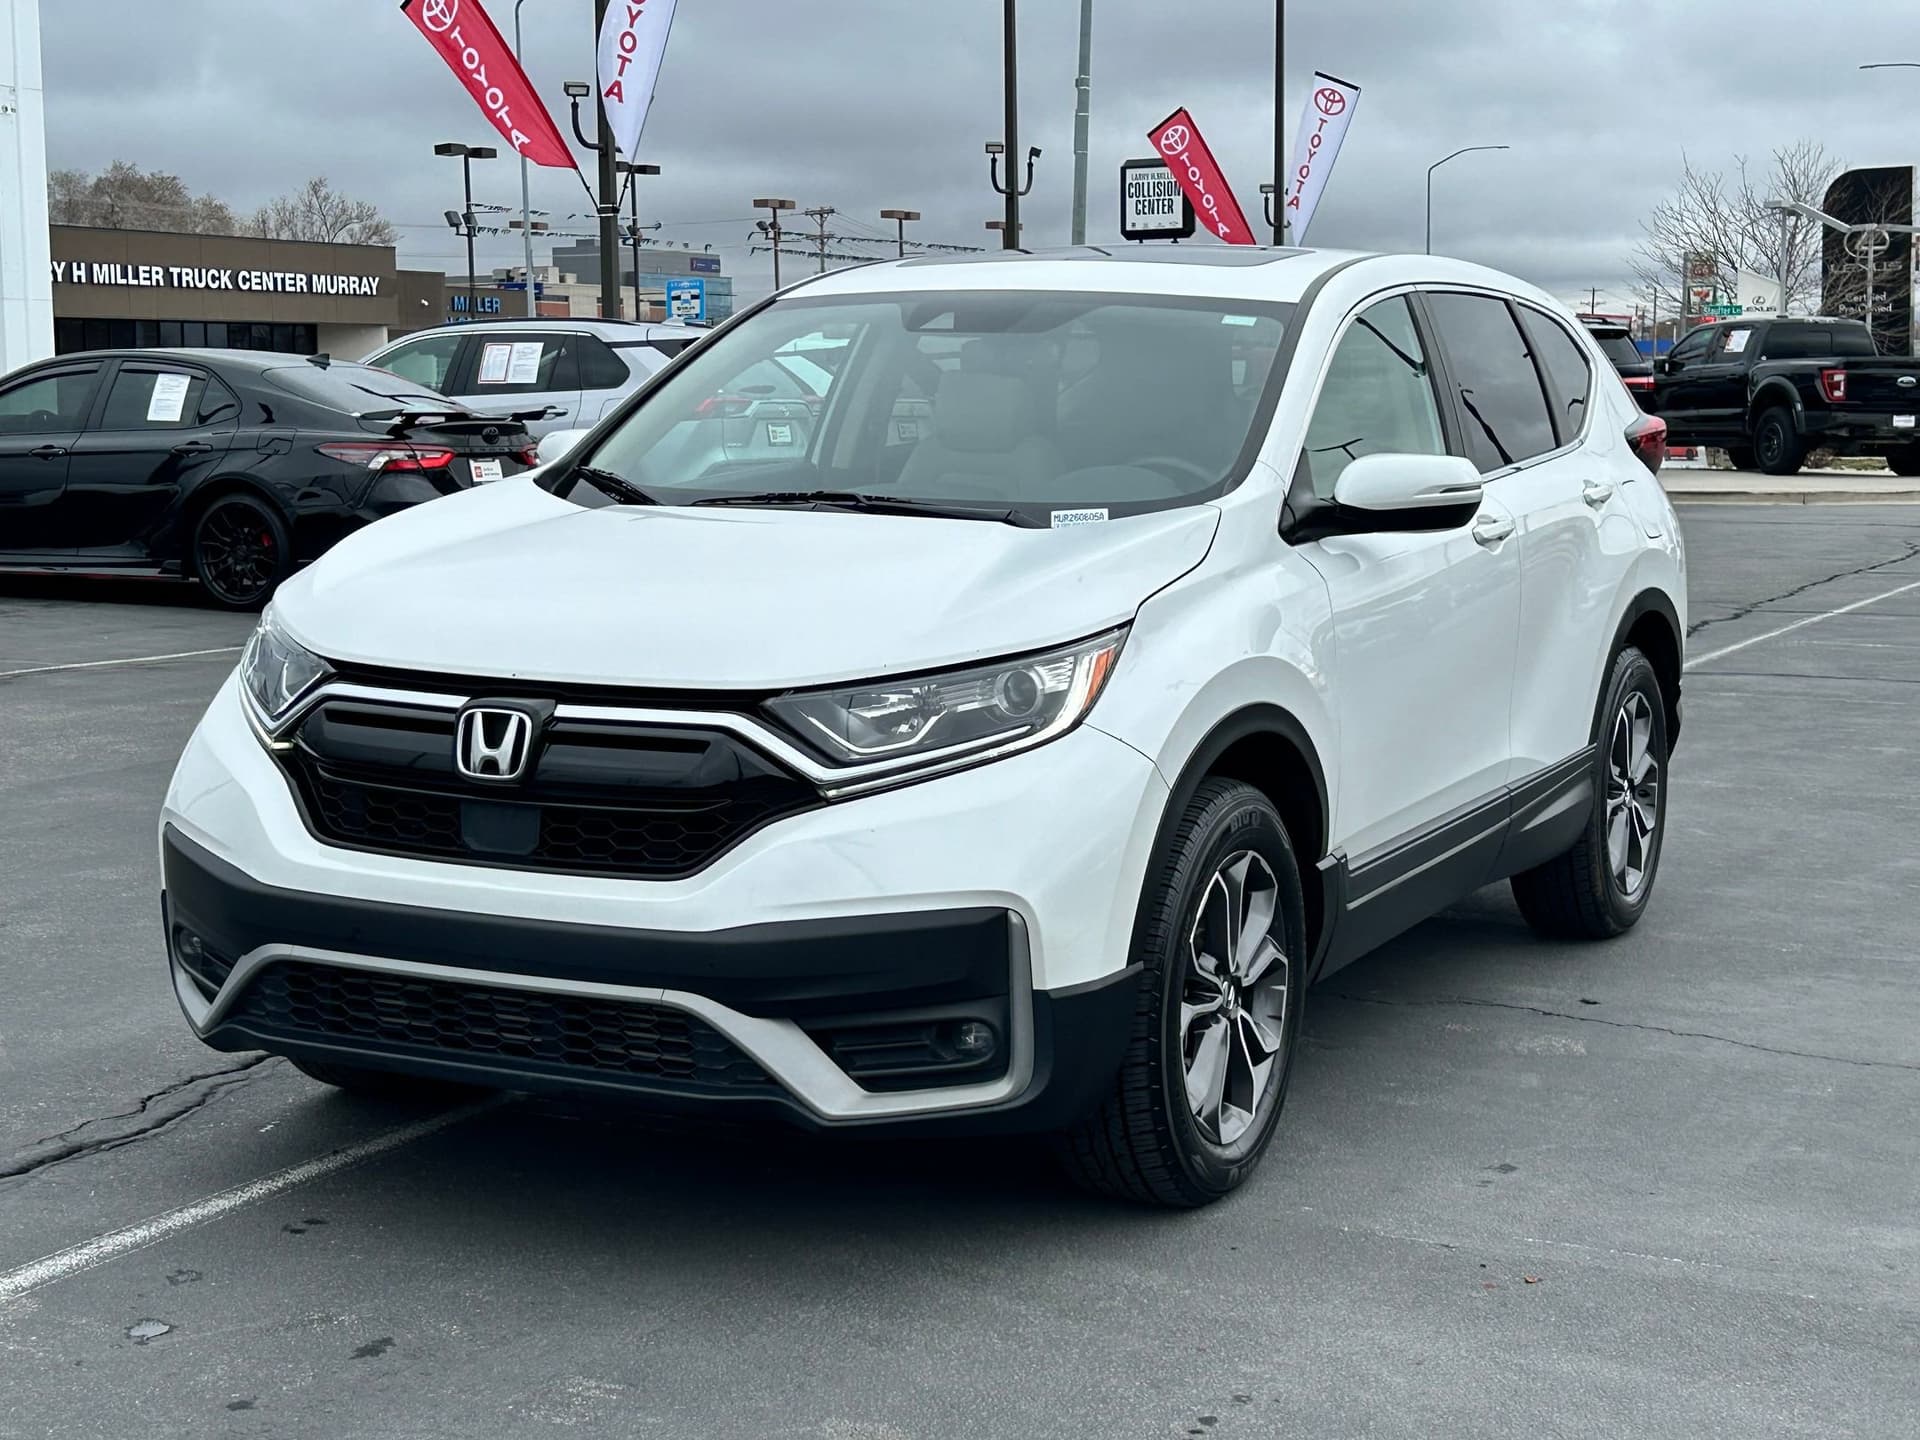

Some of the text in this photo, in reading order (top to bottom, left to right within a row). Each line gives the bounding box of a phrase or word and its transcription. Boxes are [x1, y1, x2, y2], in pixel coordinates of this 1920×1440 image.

[451, 27, 531, 151] TOYOTA
[1286, 117, 1328, 210] TOYOTA
[1127, 180, 1181, 199] COLLISION
[1179, 152, 1231, 238] TOYOTA
[1135, 198, 1174, 216] CENTER
[72, 261, 87, 283] H
[92, 263, 164, 287] MILLER
[169, 266, 232, 290] TRUCK
[237, 270, 308, 293] CENTER
[312, 274, 379, 296] MURRAY
[453, 295, 501, 314] MILER
[1846, 291, 1887, 302] Certied
